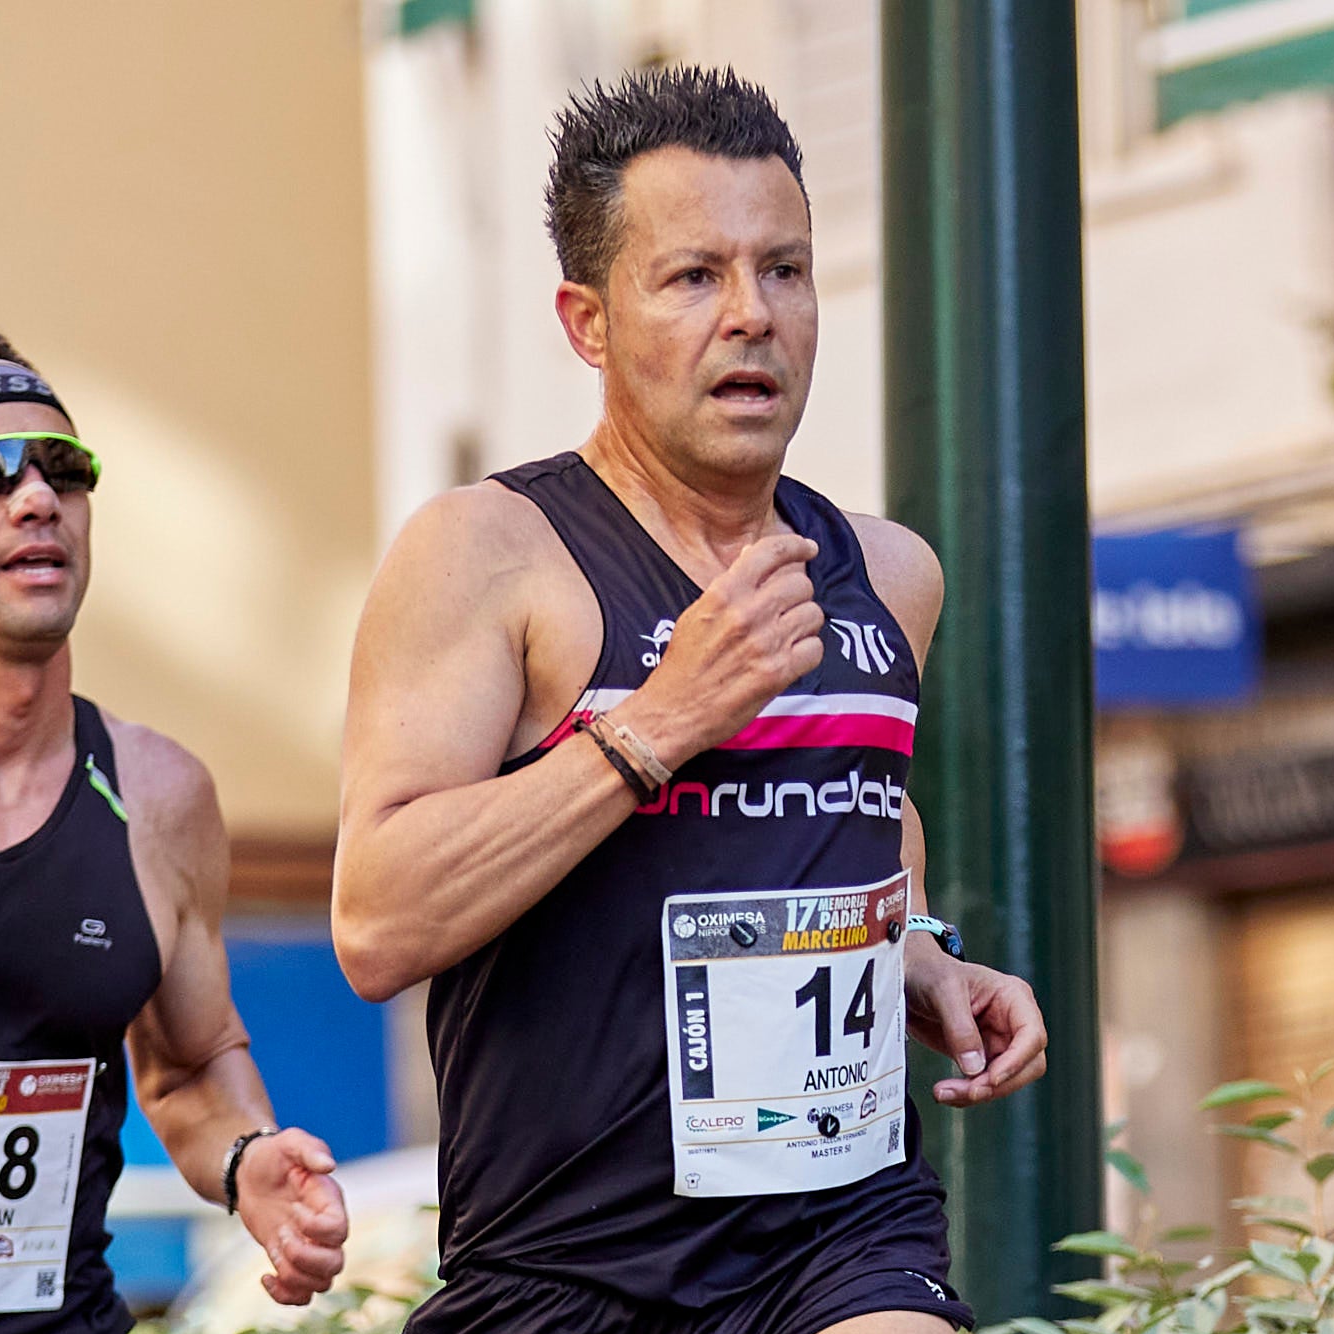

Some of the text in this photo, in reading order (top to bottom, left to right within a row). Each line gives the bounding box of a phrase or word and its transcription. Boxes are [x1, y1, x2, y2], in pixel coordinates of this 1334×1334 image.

[786, 898, 819, 932] 17
[818, 894, 868, 911] MEMORIAL
[819, 908, 865, 930] PADRE
[782, 925, 868, 951] MARCELINO
[795, 958, 875, 1057] 14
[683, 992, 708, 1071] CAJÓN 1
[803, 1060, 868, 1091] ANTONIO
[812, 1146, 843, 1158] MASTER
